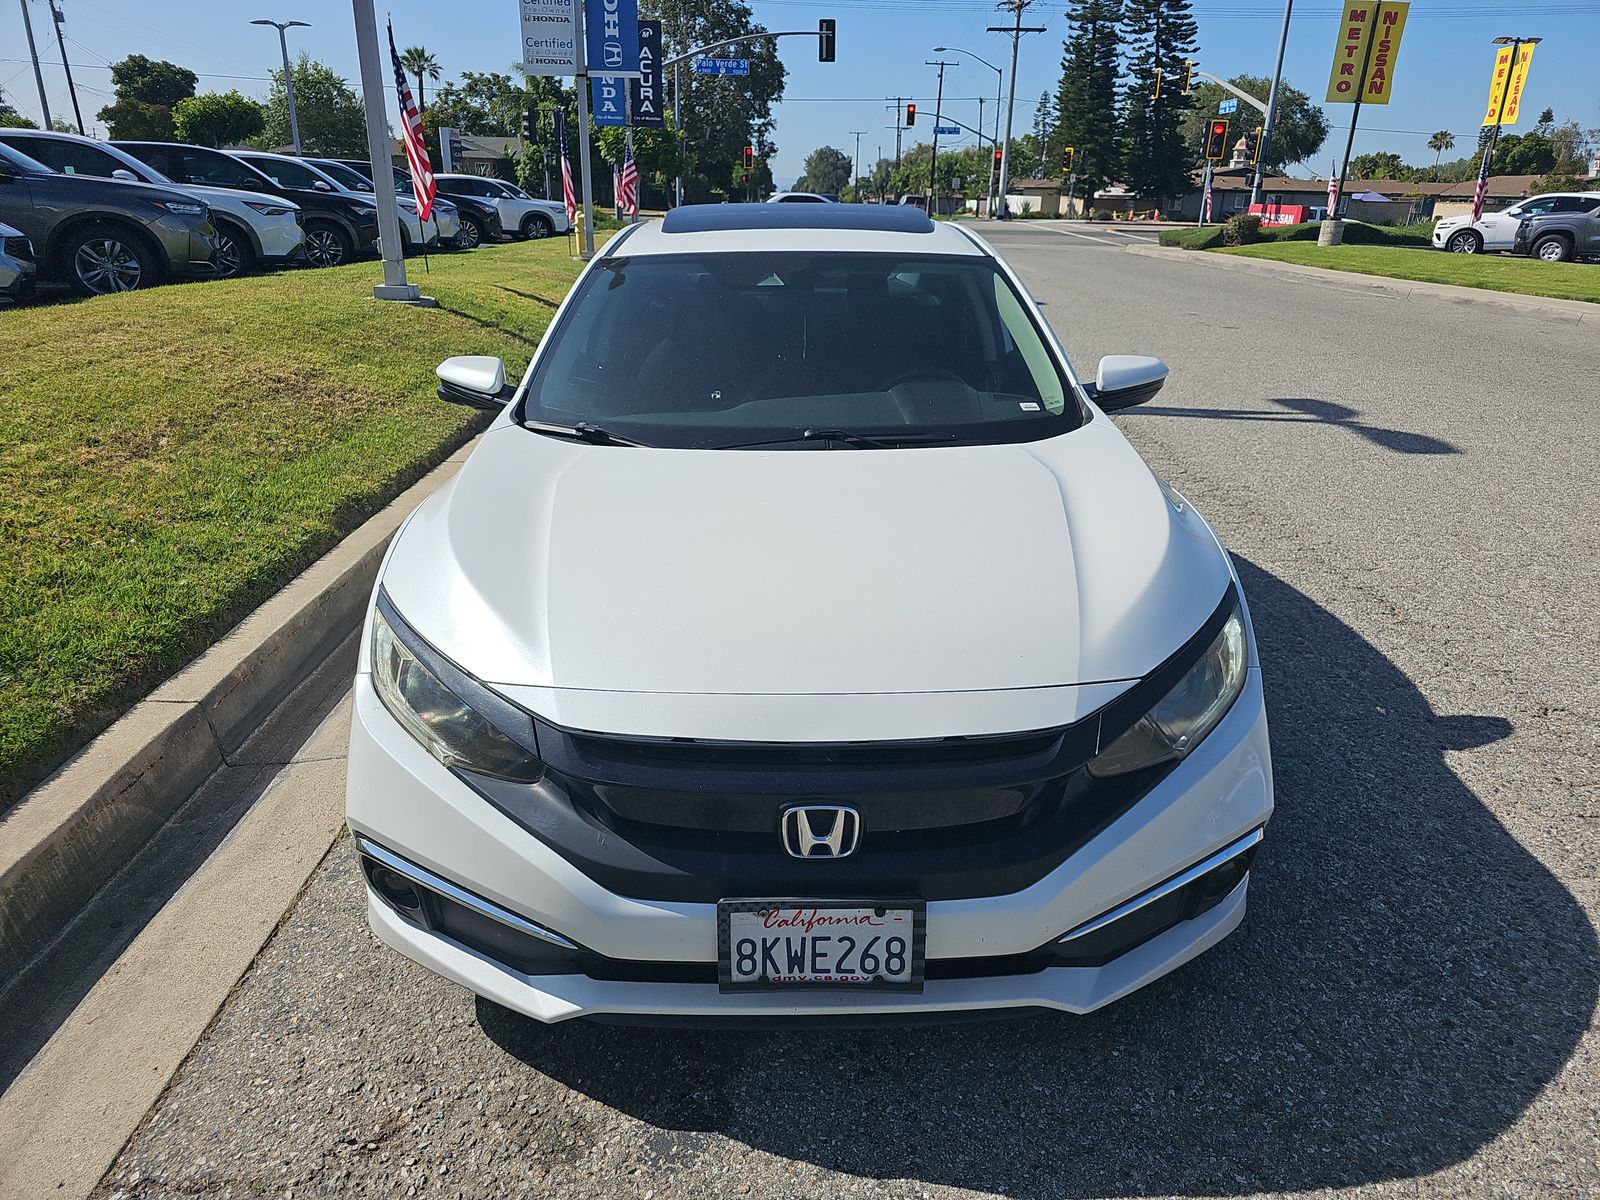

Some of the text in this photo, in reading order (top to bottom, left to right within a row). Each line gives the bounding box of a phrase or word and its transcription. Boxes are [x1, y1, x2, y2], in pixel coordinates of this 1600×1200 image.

[532, 15, 571, 23] HONDA
[525, 37, 573, 49] Certified
[1336, 9, 1367, 93] METRO
[1368, 11, 1399, 94] NISSAN
[715, 60, 737, 68] Verde
[740, 60, 748, 68] St
[639, 46, 655, 113] ACURA
[1270, 214, 1295, 225] NISSAN
[763, 908, 884, 933] California
[736, 936, 906, 976] 8KWE268
[772, 975, 870, 983] dmv.ca.gov
